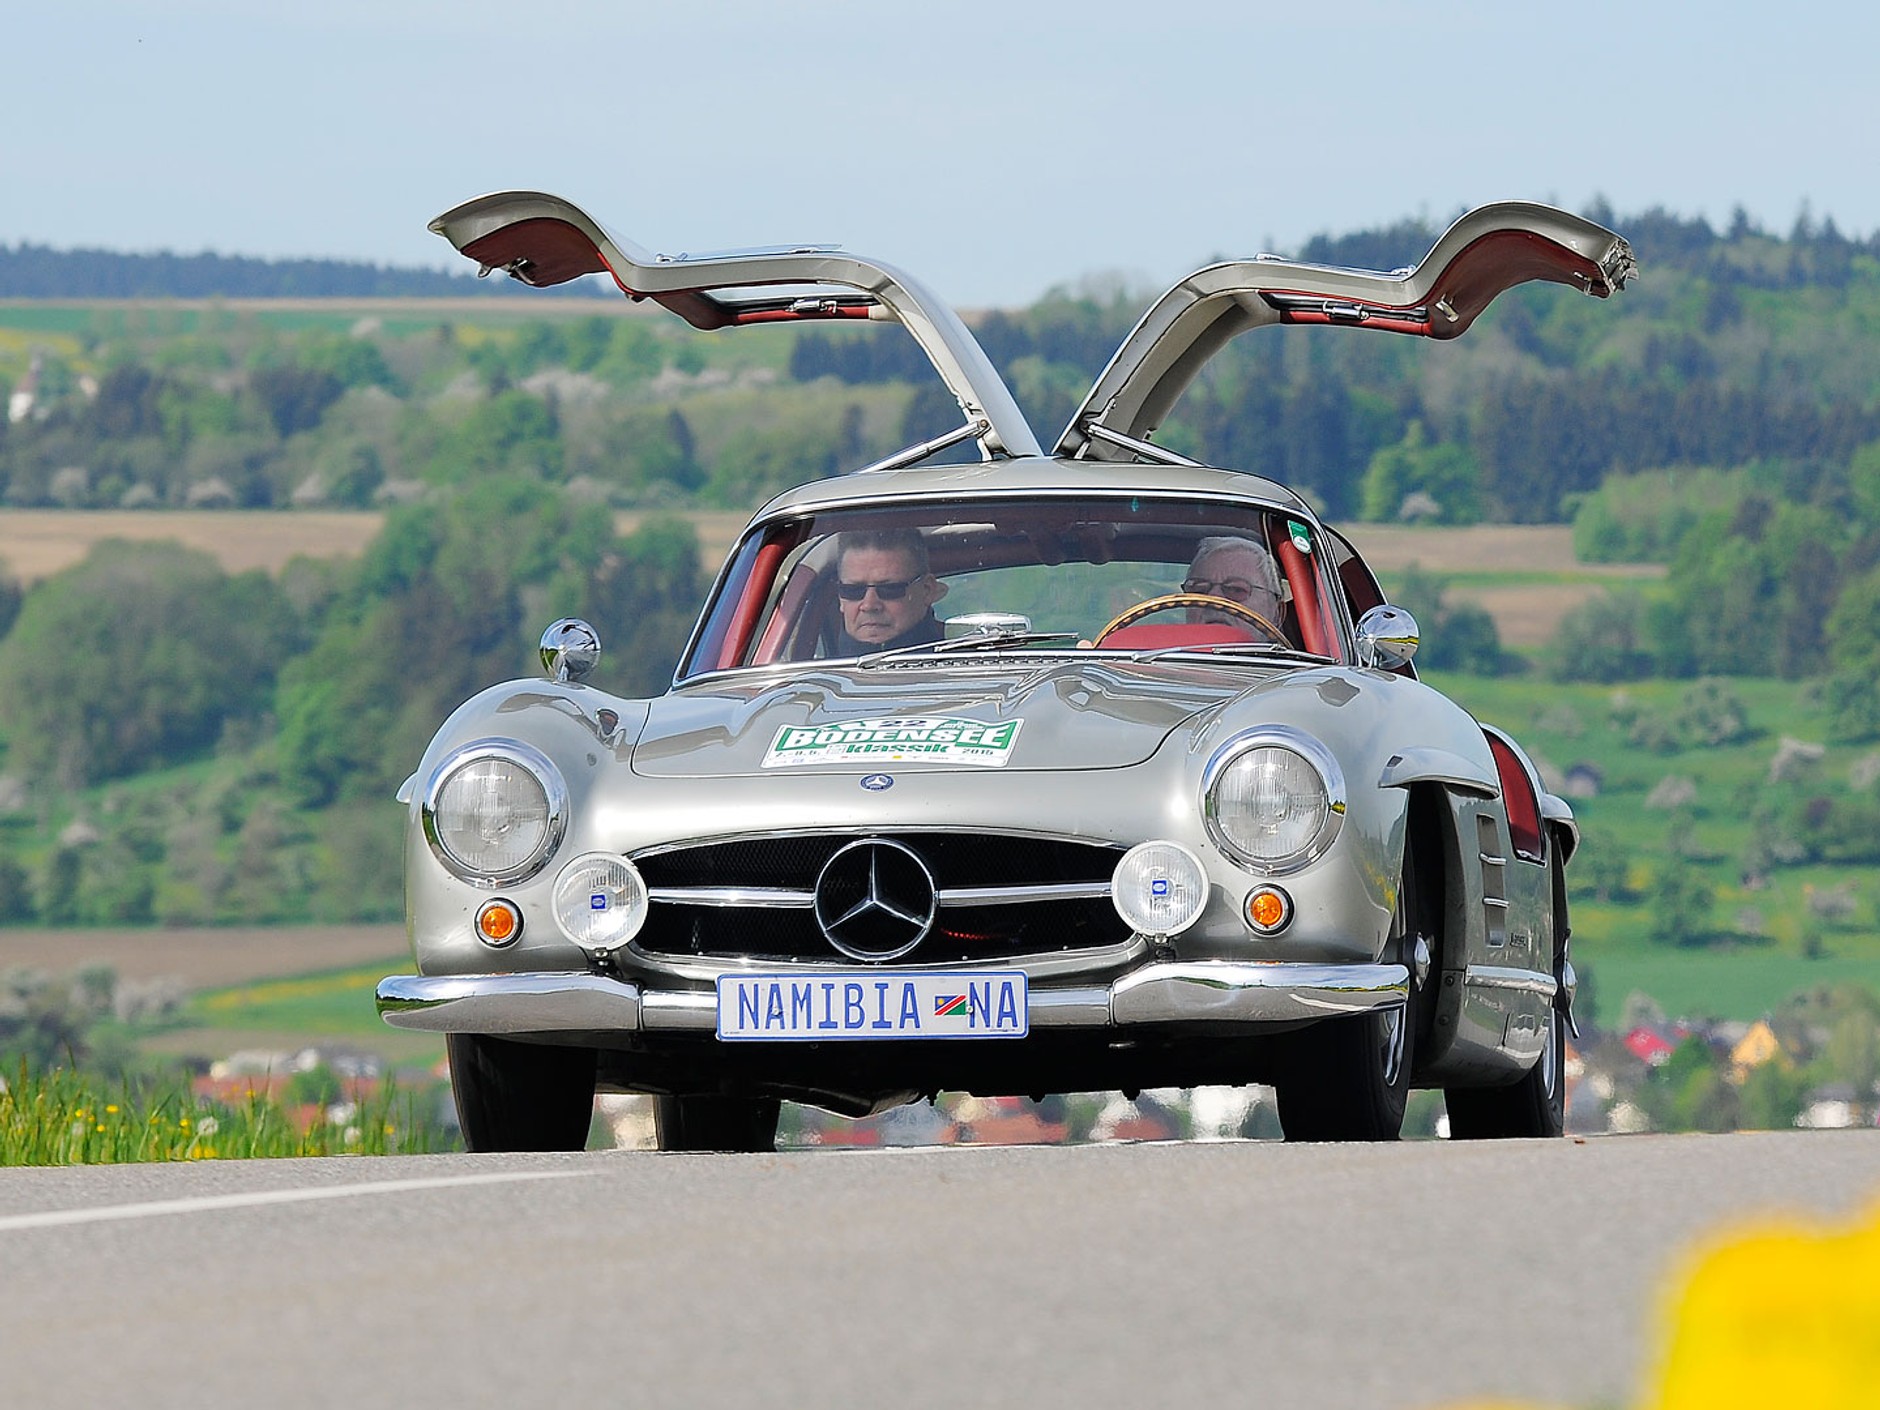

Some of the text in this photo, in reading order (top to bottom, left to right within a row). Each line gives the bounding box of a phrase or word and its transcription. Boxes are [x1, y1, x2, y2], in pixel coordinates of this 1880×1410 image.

[879, 719, 928, 728] 22
[781, 723, 1013, 749] BODENSEE
[845, 744, 951, 753] klassik
[738, 981, 1018, 1030] NAMIBIA NA
